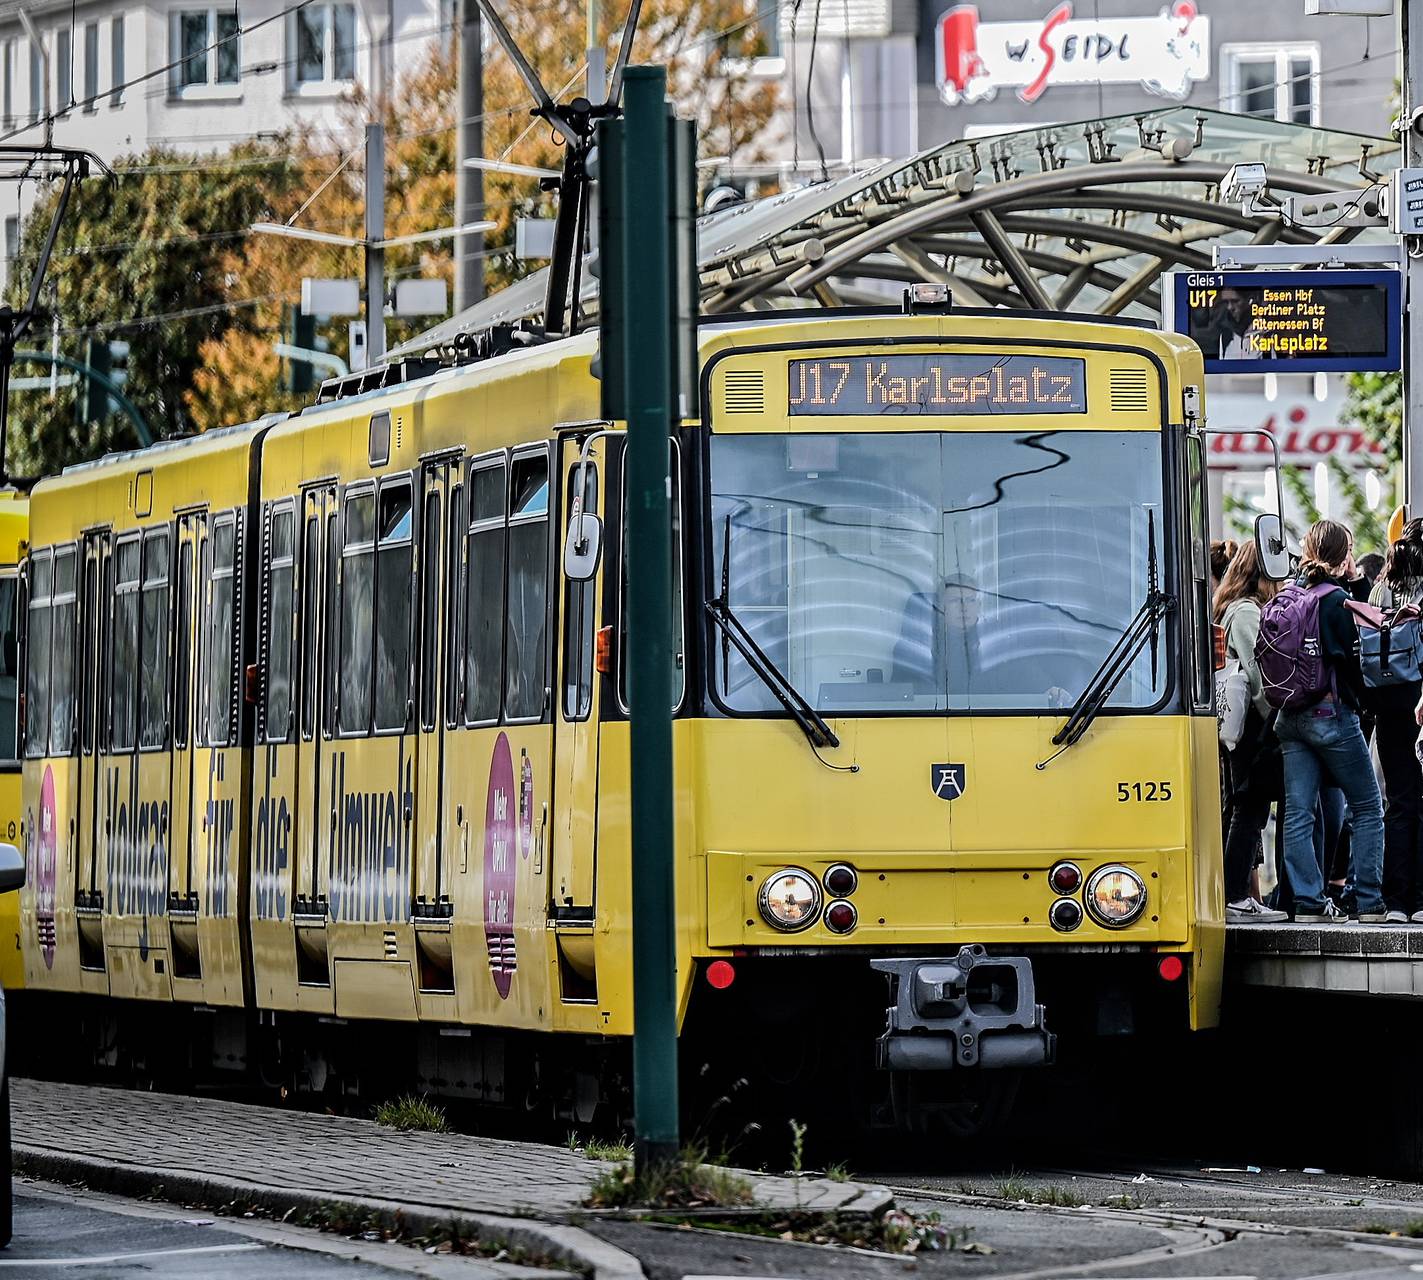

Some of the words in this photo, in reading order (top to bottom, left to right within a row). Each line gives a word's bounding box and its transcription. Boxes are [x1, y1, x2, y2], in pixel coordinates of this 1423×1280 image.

[1022, 5, 1131, 98] SEIDL
[1187, 274, 1215, 287] Gleis
[1218, 275, 1224, 286] 1
[1189, 289, 1217, 308] U17
[1263, 289, 1292, 302] Essen
[1295, 289, 1313, 302] Hbf
[1251, 304, 1294, 316] Berliner
[1297, 305, 1326, 316] Platz
[1252, 318, 1309, 330] Altenessen
[1312, 318, 1325, 331] Bf
[1250, 333, 1328, 354] Karlsplatz
[865, 362, 1073, 404] Karlsplatz
[1117, 781, 1172, 802] 5125
[493, 786, 508, 821] Mehr
[206, 748, 234, 918] für
[255, 745, 289, 921] die
